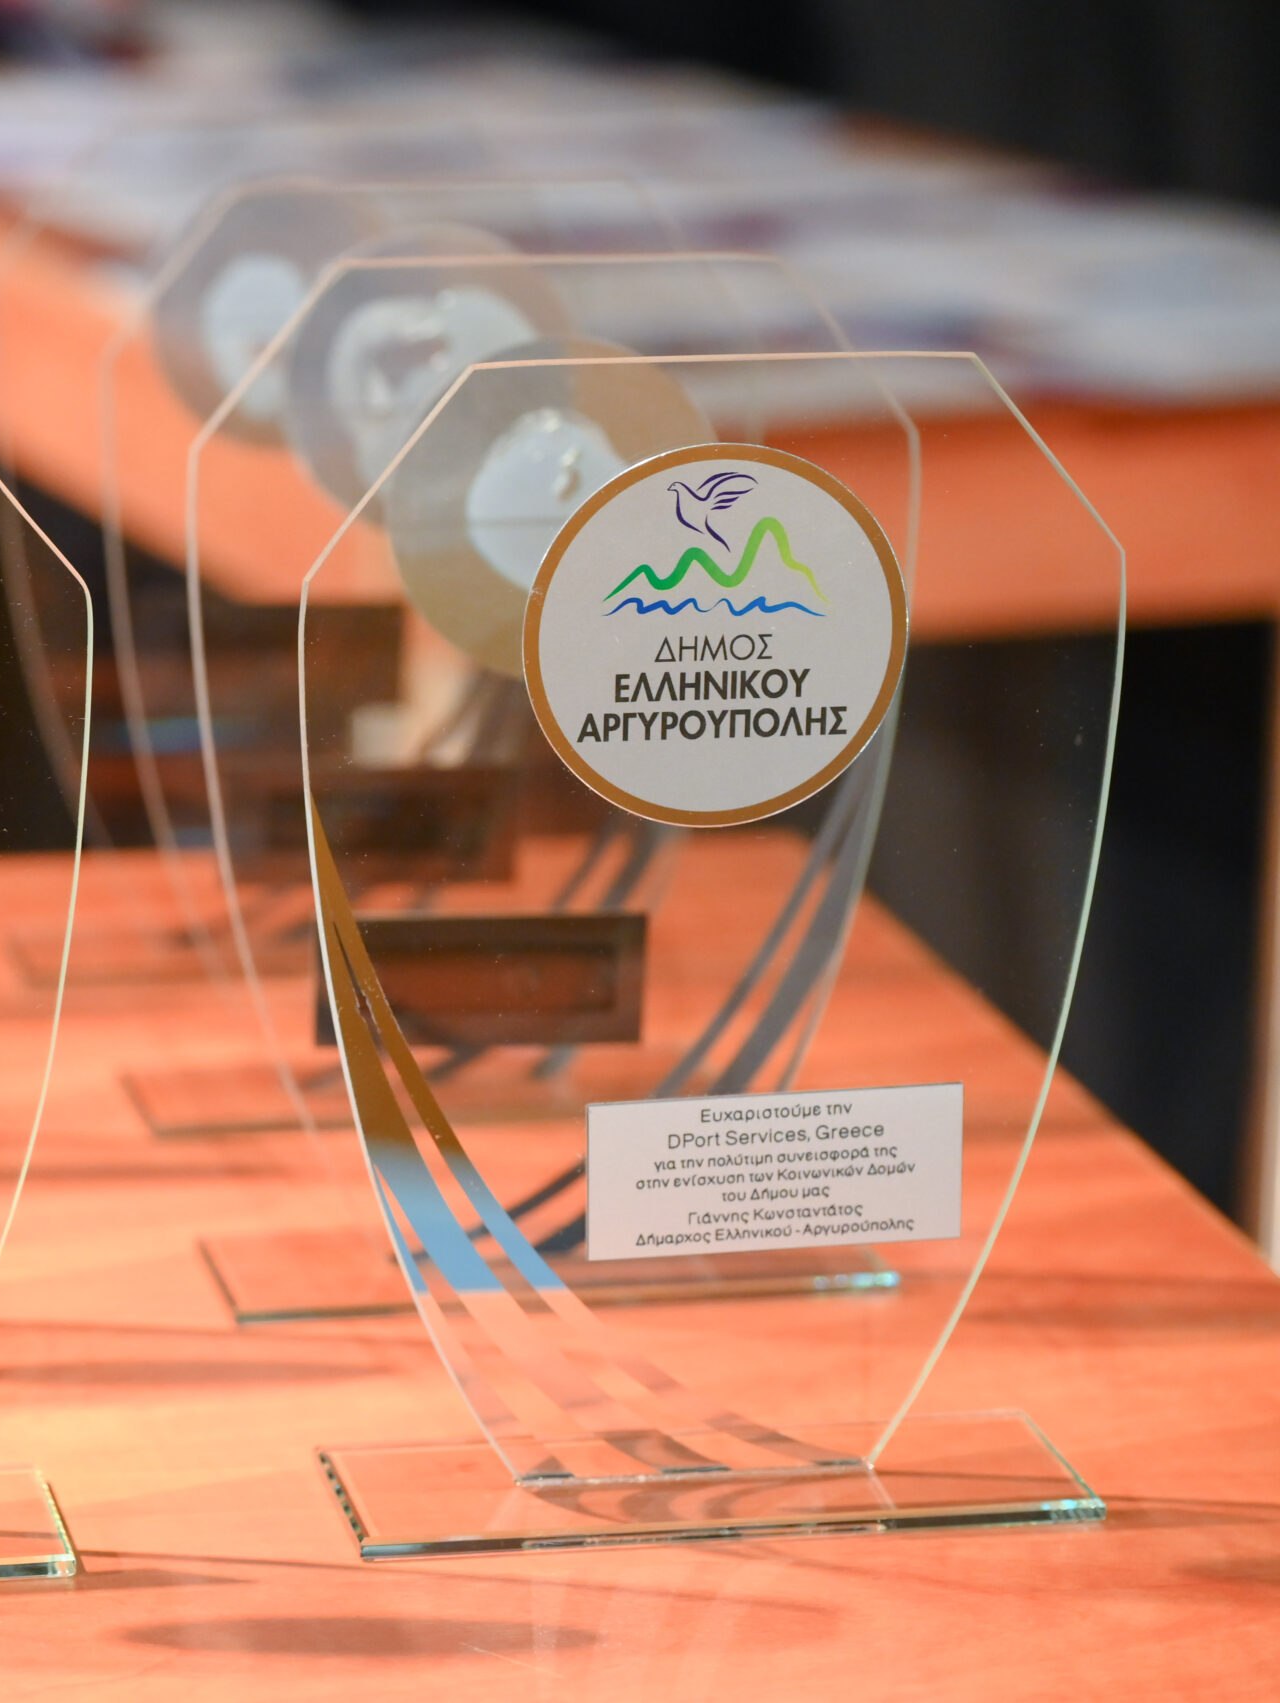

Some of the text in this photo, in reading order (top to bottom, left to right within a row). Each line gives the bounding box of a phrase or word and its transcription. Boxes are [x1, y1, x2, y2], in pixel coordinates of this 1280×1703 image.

[655, 634, 772, 662] ΔΗΜΟΣ
[615, 669, 810, 702] ΕΛΛΗΝΙΚΟΥ
[577, 706, 847, 742] ΑΡΓΥΡΟΥΠΟΛΗΣ
[700, 1103, 853, 1124] Ευχαριστούμε την
[667, 1124, 885, 1150] DPort Services, Greece
[653, 1145, 898, 1173] για την πολύτιμη συνεισφορά της
[635, 1161, 916, 1190] στην ενίσχυση των Κοινωνικών Δομών
[721, 1185, 830, 1202] του Δήμου μας
[688, 1204, 863, 1225] Γιάννης Κωνσταντάτος
[635, 1231, 711, 1247] Δήμαρχος
[714, 1224, 793, 1242] Ελληνικού
